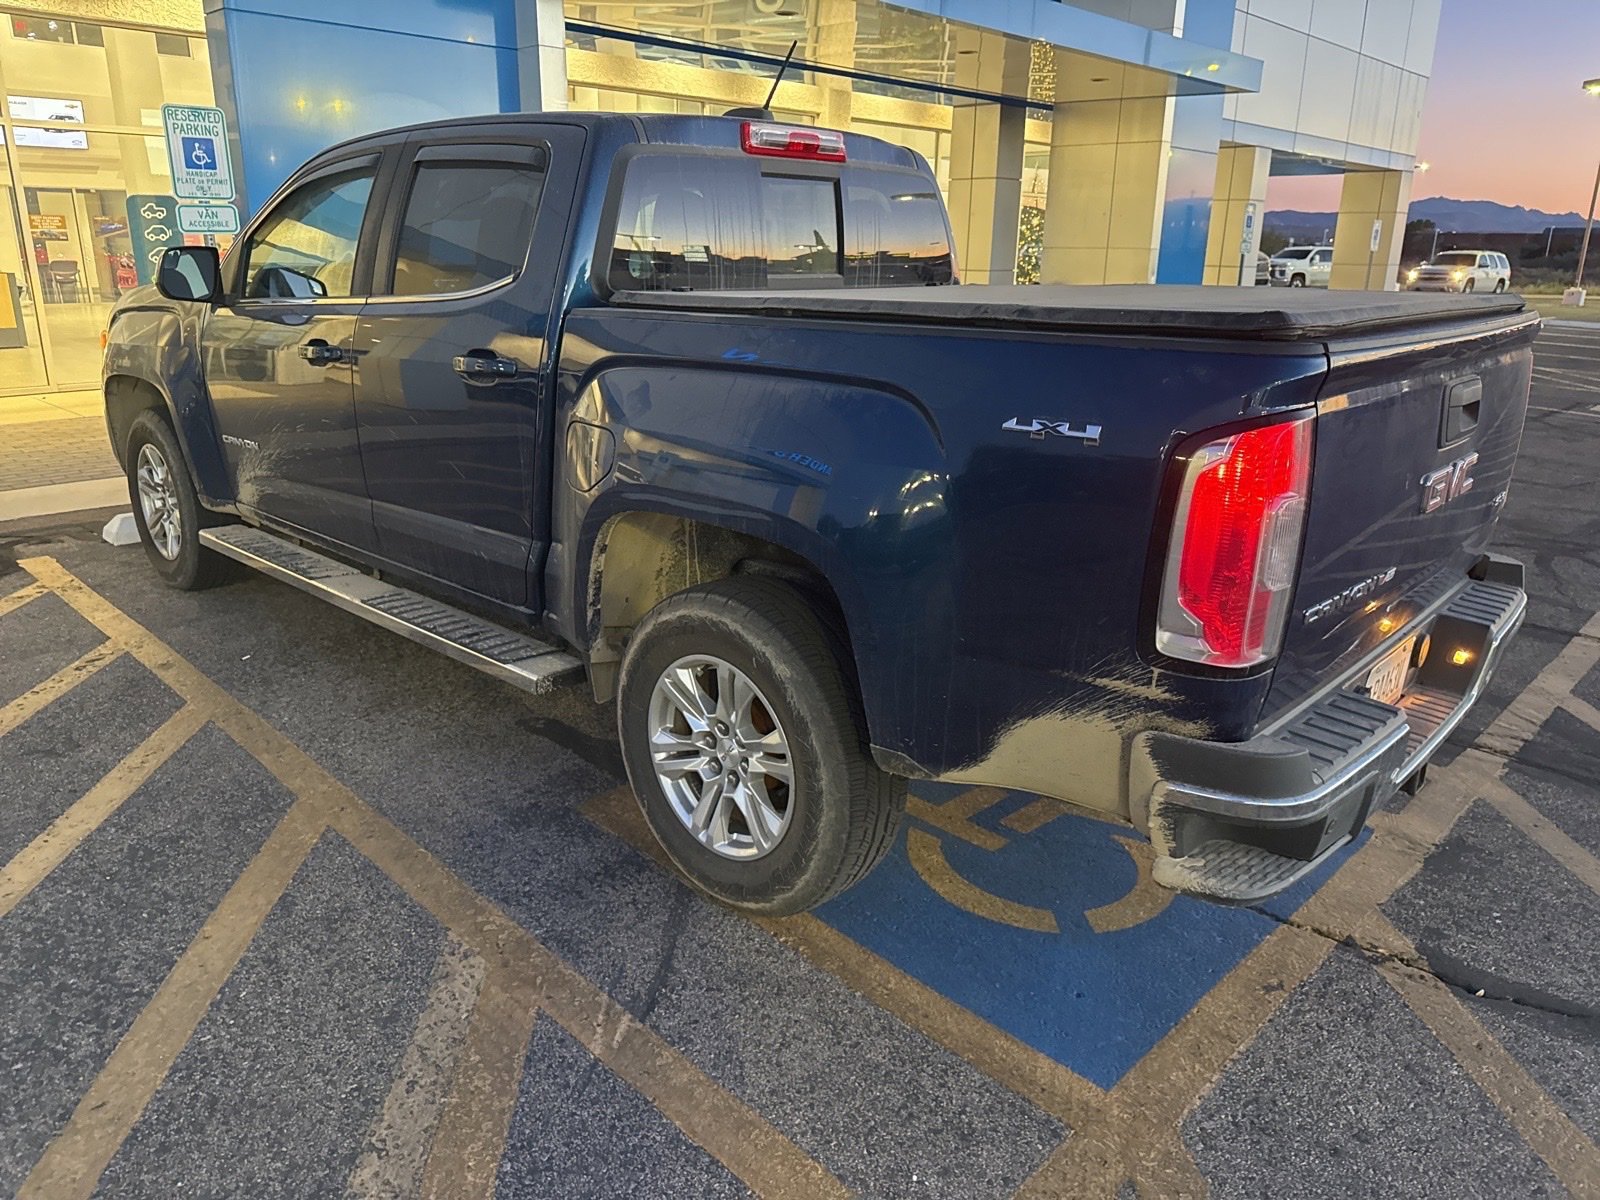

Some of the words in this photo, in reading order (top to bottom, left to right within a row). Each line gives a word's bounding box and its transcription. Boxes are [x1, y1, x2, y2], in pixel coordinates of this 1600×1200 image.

[167, 109, 221, 124] RESERVED
[172, 122, 219, 137] PARKING
[177, 177, 196, 185] PLATE
[186, 170, 218, 178] HANDICAP
[197, 210, 219, 219] VAN
[188, 220, 229, 228] ACCESSIBLE
[222, 434, 260, 450] CANYON
[1420, 450, 1479, 513] GMC
[1303, 574, 1377, 624] CANYON
